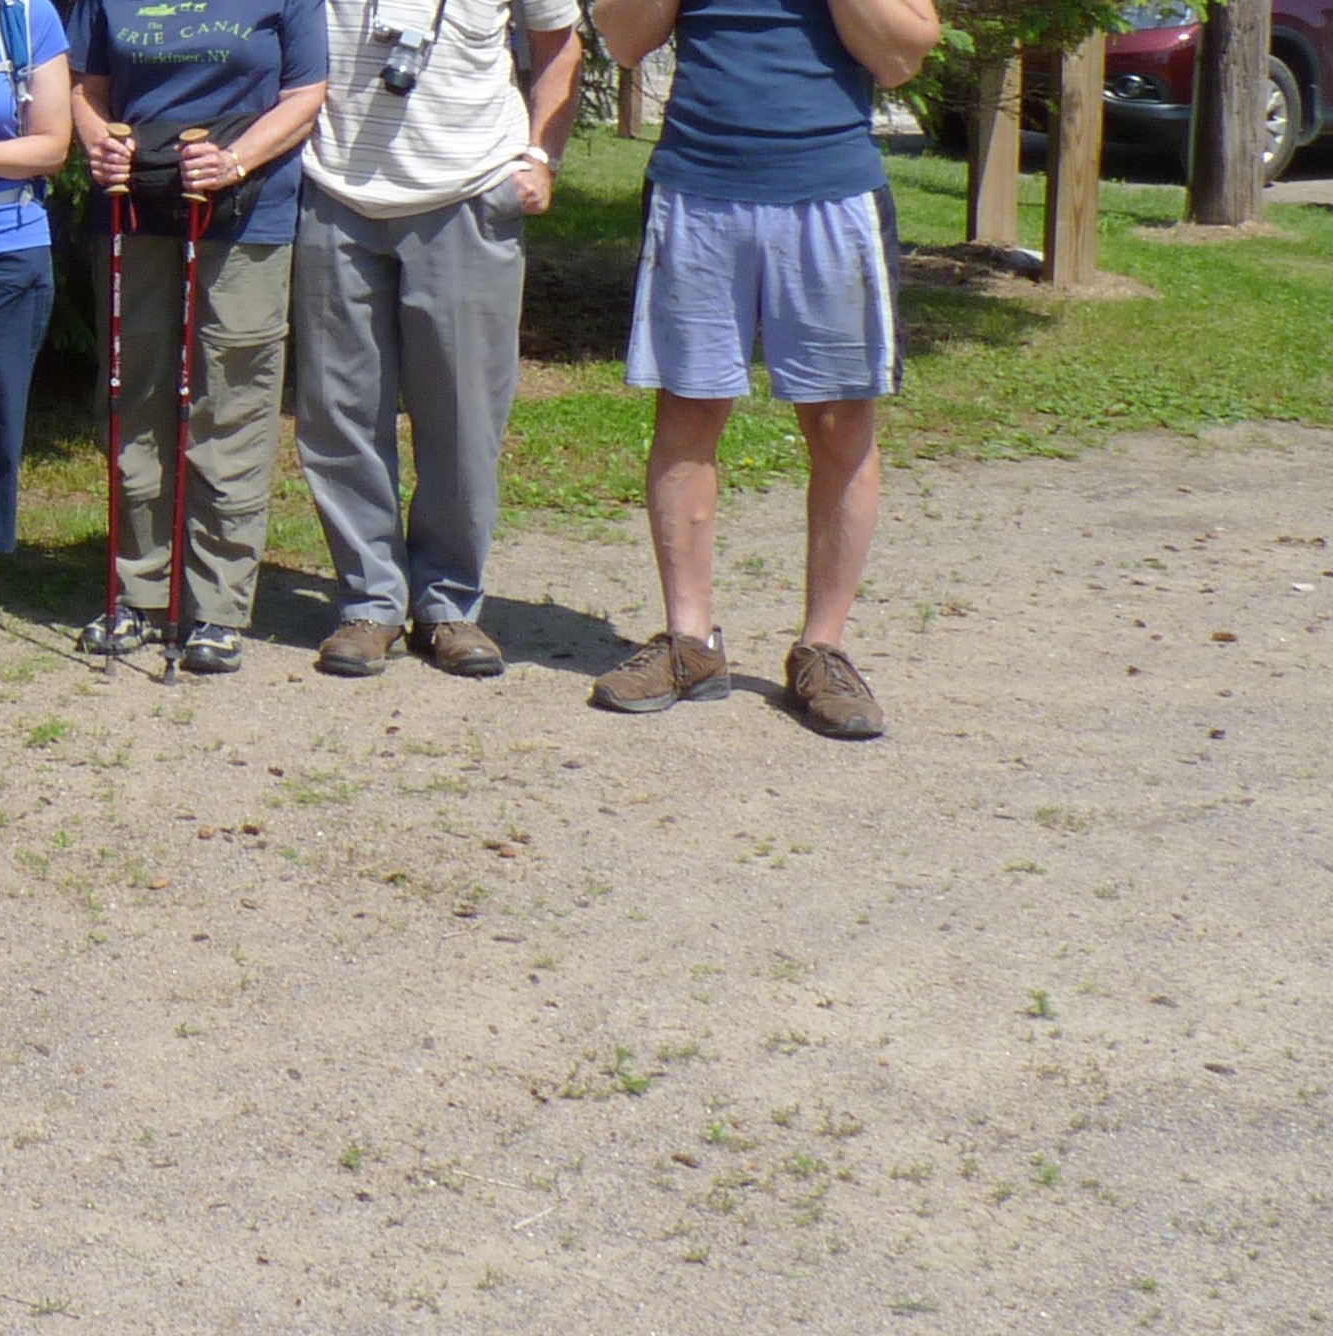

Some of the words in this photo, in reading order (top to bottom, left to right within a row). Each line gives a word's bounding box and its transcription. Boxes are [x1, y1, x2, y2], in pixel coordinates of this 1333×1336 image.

[117, 27, 165, 46] ERIE
[179, 20, 255, 42] CANAL
[207, 49, 230, 64] NY
